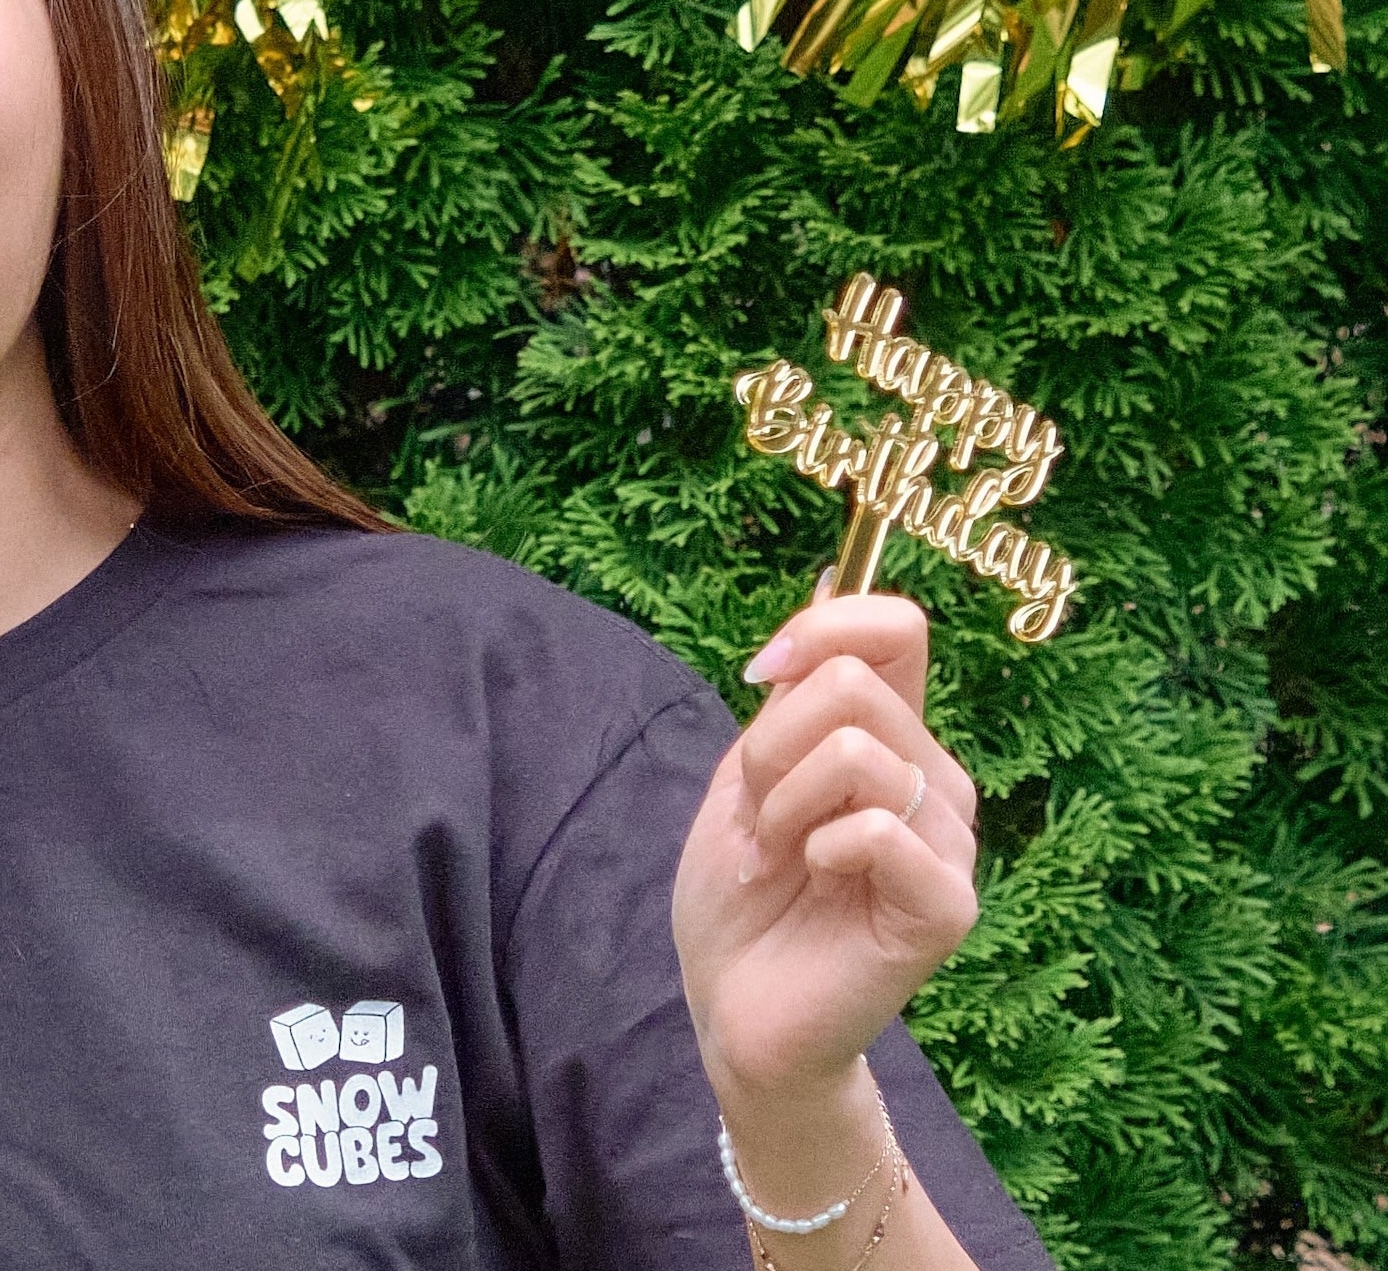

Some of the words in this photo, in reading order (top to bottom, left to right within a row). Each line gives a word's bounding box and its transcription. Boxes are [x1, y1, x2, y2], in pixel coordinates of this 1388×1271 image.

[822, 271, 1065, 506] Happy
[734, 358, 1078, 643] Birthday
[262, 1064, 438, 1140] SNOW
[266, 1118, 444, 1188] CUBES
